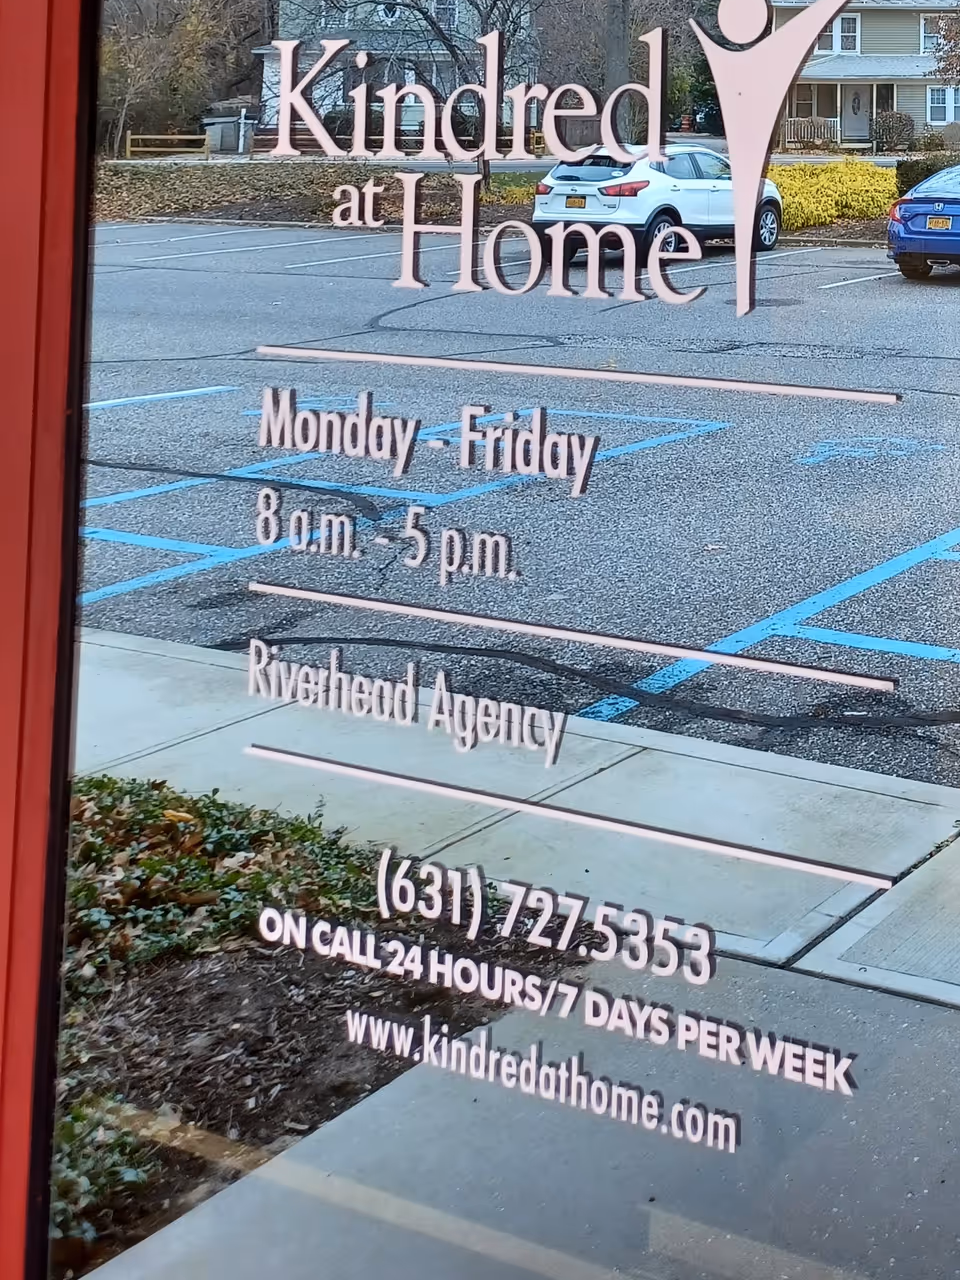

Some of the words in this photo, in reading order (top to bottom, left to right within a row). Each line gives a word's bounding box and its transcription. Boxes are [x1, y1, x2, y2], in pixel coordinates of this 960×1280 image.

[270, 27, 670, 164] Kindred
[331, 179, 386, 228] at
[391, 171, 709, 306] Home
[258, 387, 420, 477] Monday
[459, 404, 600, 497] Friday
[255, 486, 282, 546] 8
[288, 509, 361, 558] a.m.
[402, 506, 429, 567] 5
[440, 526, 520, 586] p.m.
[247, 638, 417, 725] Riverhead
[426, 669, 568, 769] Agency
[376, 848, 485, 942] (631)
[499, 881, 717, 986] 727.5353
[258, 907, 307, 950] ON
[311, 924, 384, 970] CALL
[388, 943, 424, 981] 24
[428, 949, 580, 1020] HOURS/7
[584, 990, 672, 1047] DAYS
[677, 1013, 741, 1066] PER
[743, 1028, 858, 1097] WEEK
[344, 1009, 741, 1154] www.kindredathome.com
